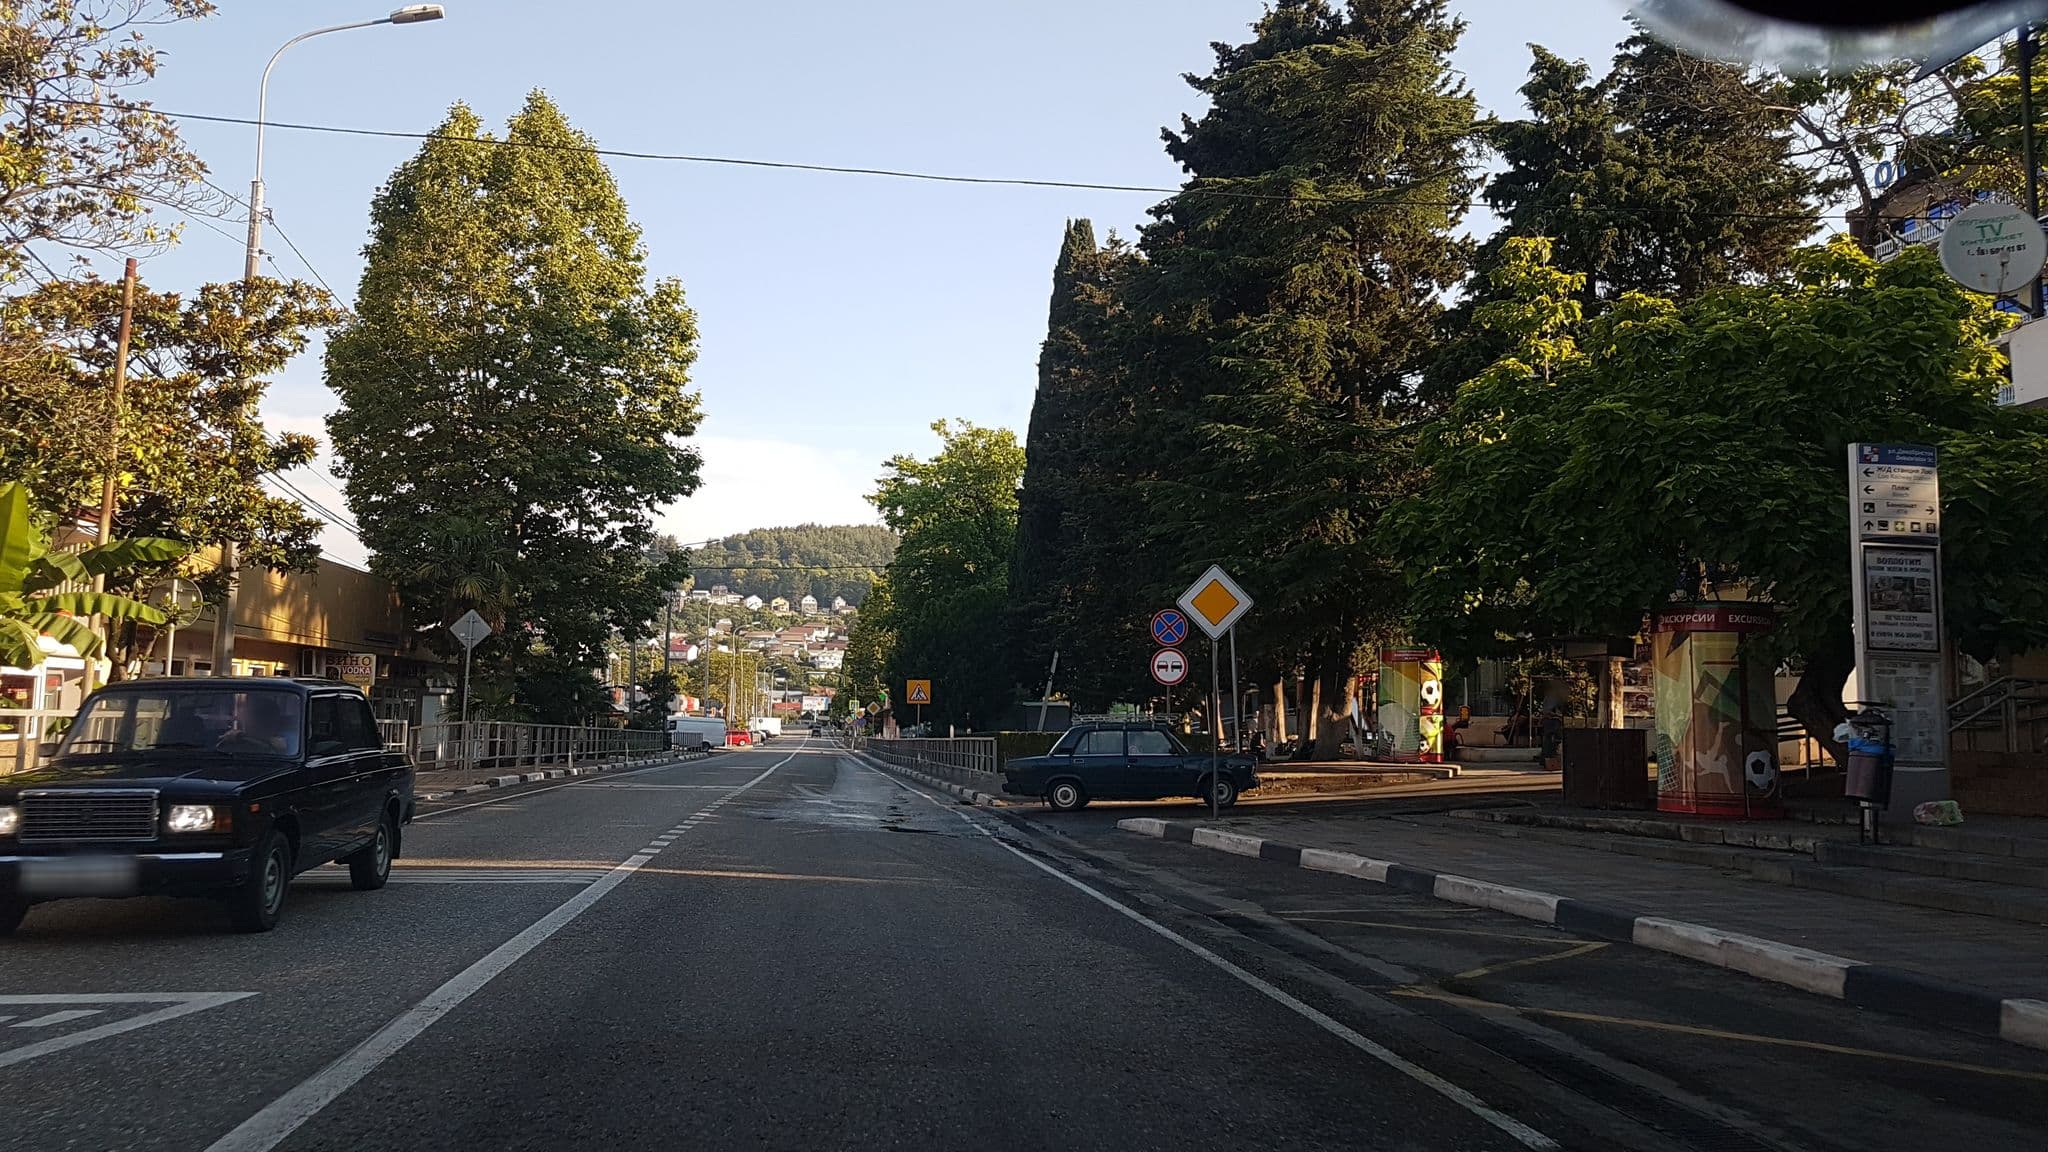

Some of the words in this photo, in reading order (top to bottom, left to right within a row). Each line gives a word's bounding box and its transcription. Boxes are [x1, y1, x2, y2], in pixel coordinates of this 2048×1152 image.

[1975, 223, 2003, 238] TV
[1658, 613, 1715, 625] ЭКСКУРСИИ
[343, 666, 371, 674] VODKA
